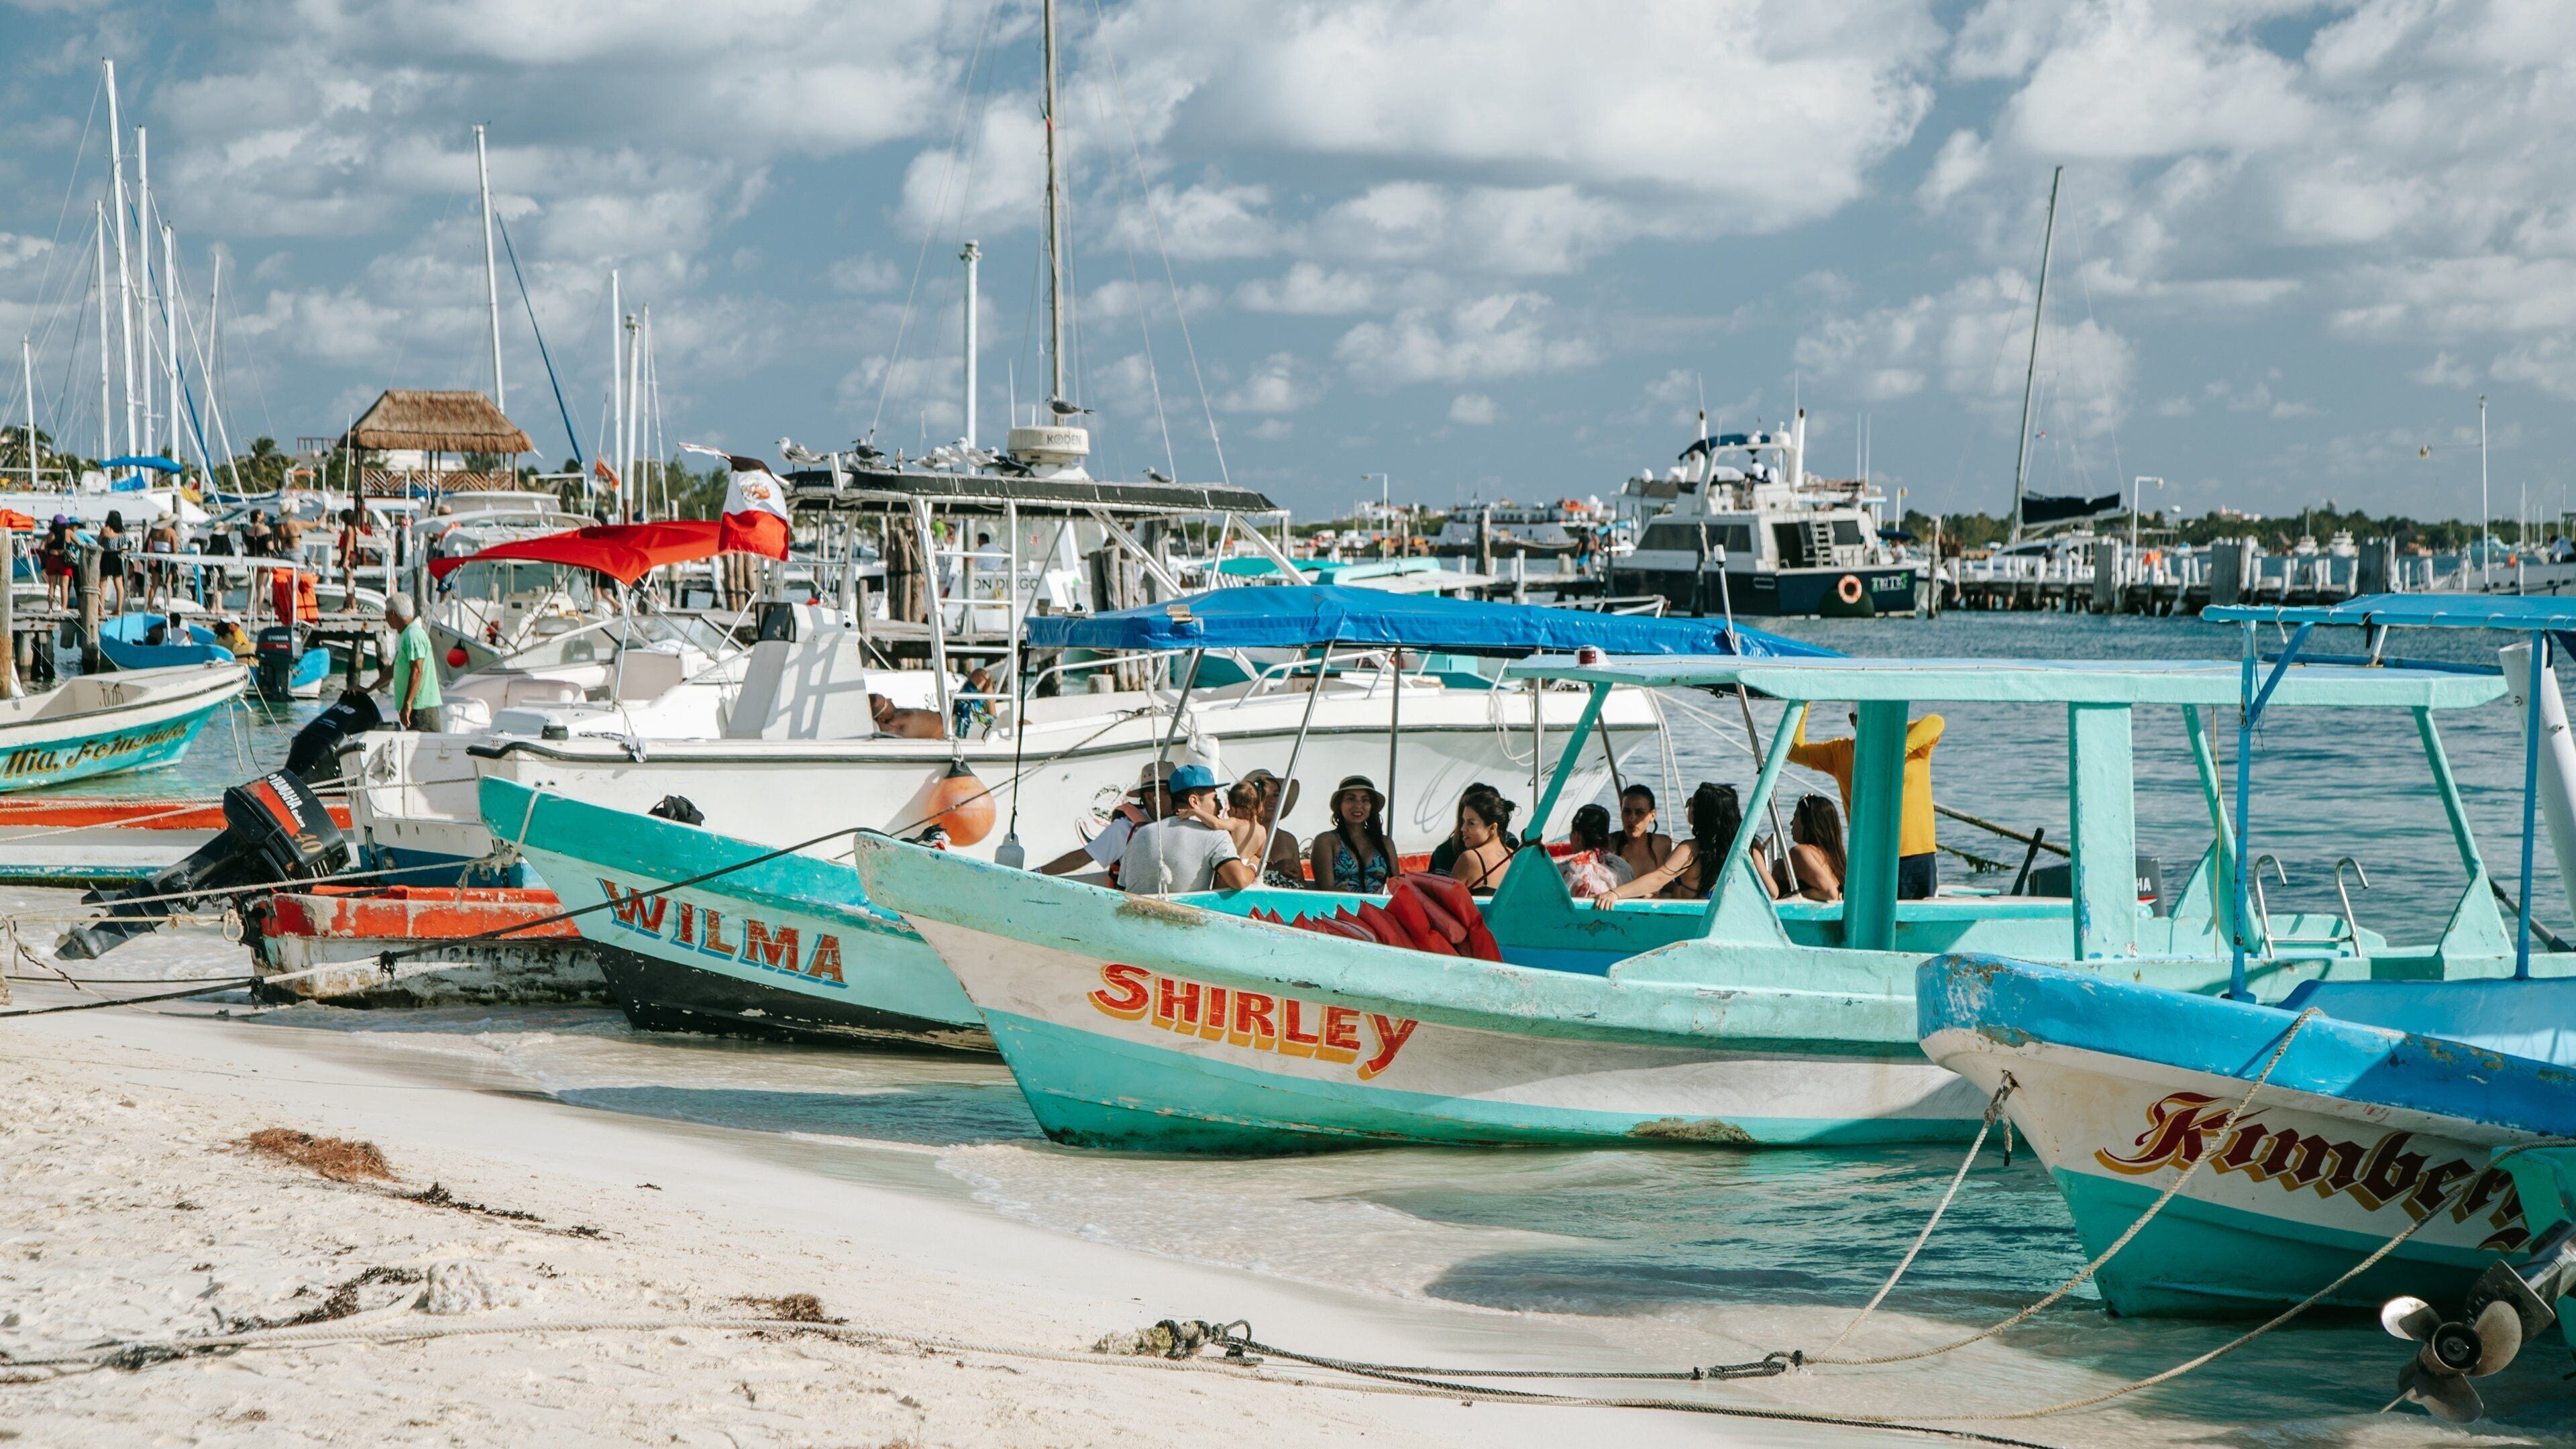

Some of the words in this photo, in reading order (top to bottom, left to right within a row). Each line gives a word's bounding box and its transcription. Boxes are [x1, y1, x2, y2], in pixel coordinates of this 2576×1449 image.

[1046, 433, 1081, 445] KODEN
[996, 578, 1040, 590] DIGO
[269, 775, 303, 810] YAMAHA
[294, 833, 323, 853] 40
[596, 877, 849, 989] WILMA
